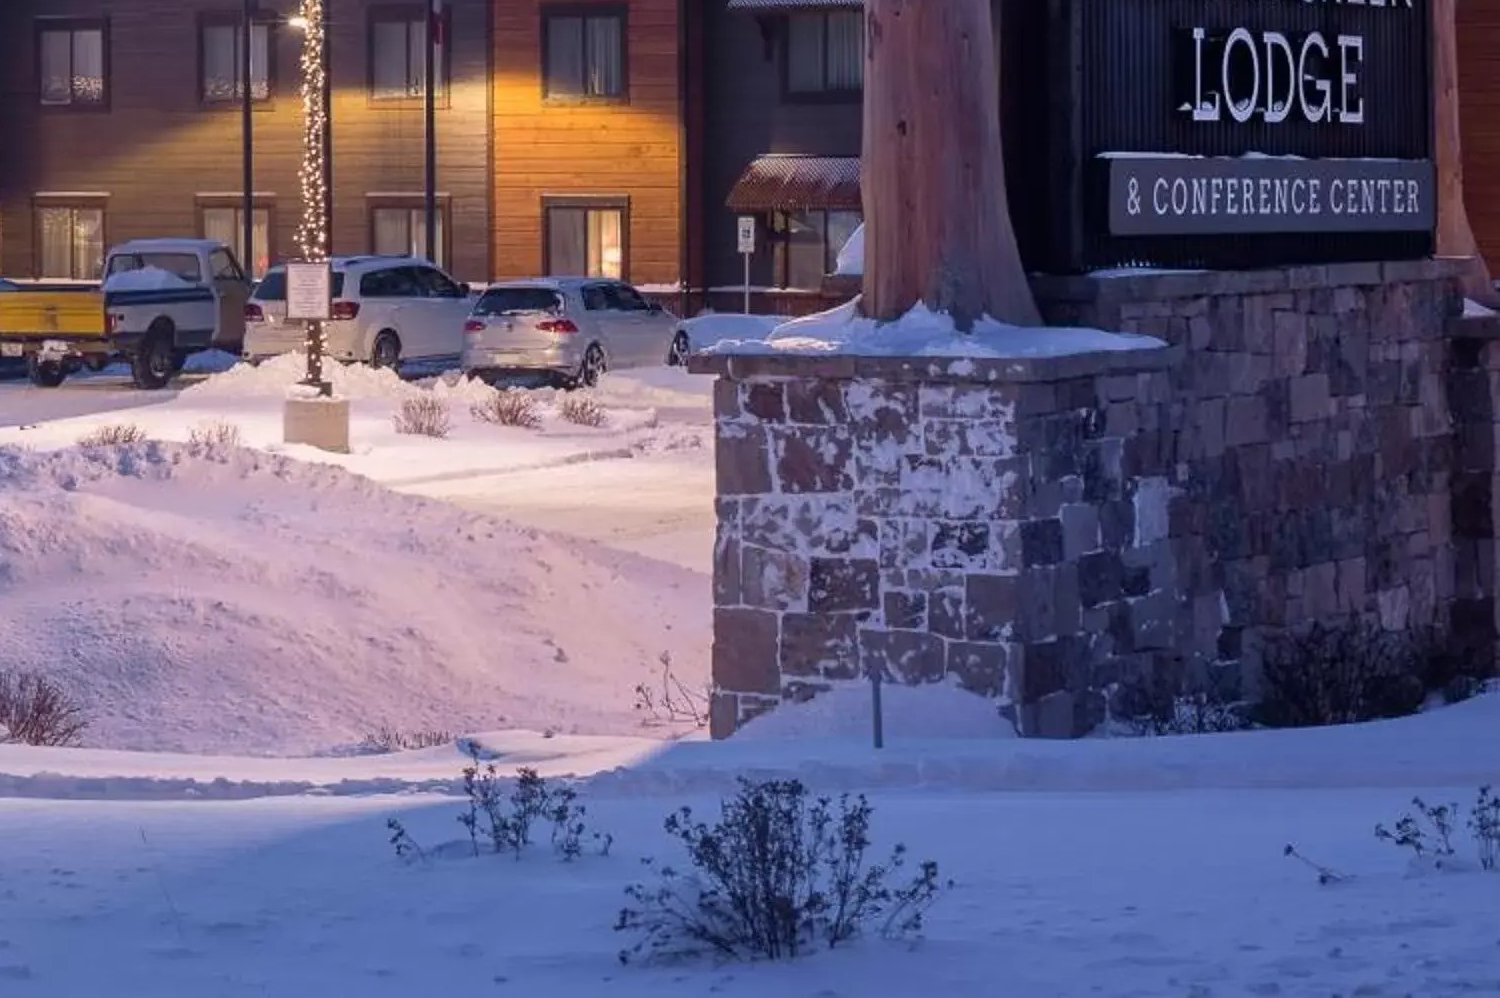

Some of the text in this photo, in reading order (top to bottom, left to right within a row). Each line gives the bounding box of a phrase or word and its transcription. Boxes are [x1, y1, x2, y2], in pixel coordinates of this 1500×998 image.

[1192, 27, 1365, 123] LODGE
[1126, 177, 1420, 216] & CONFERENCE CENTER
